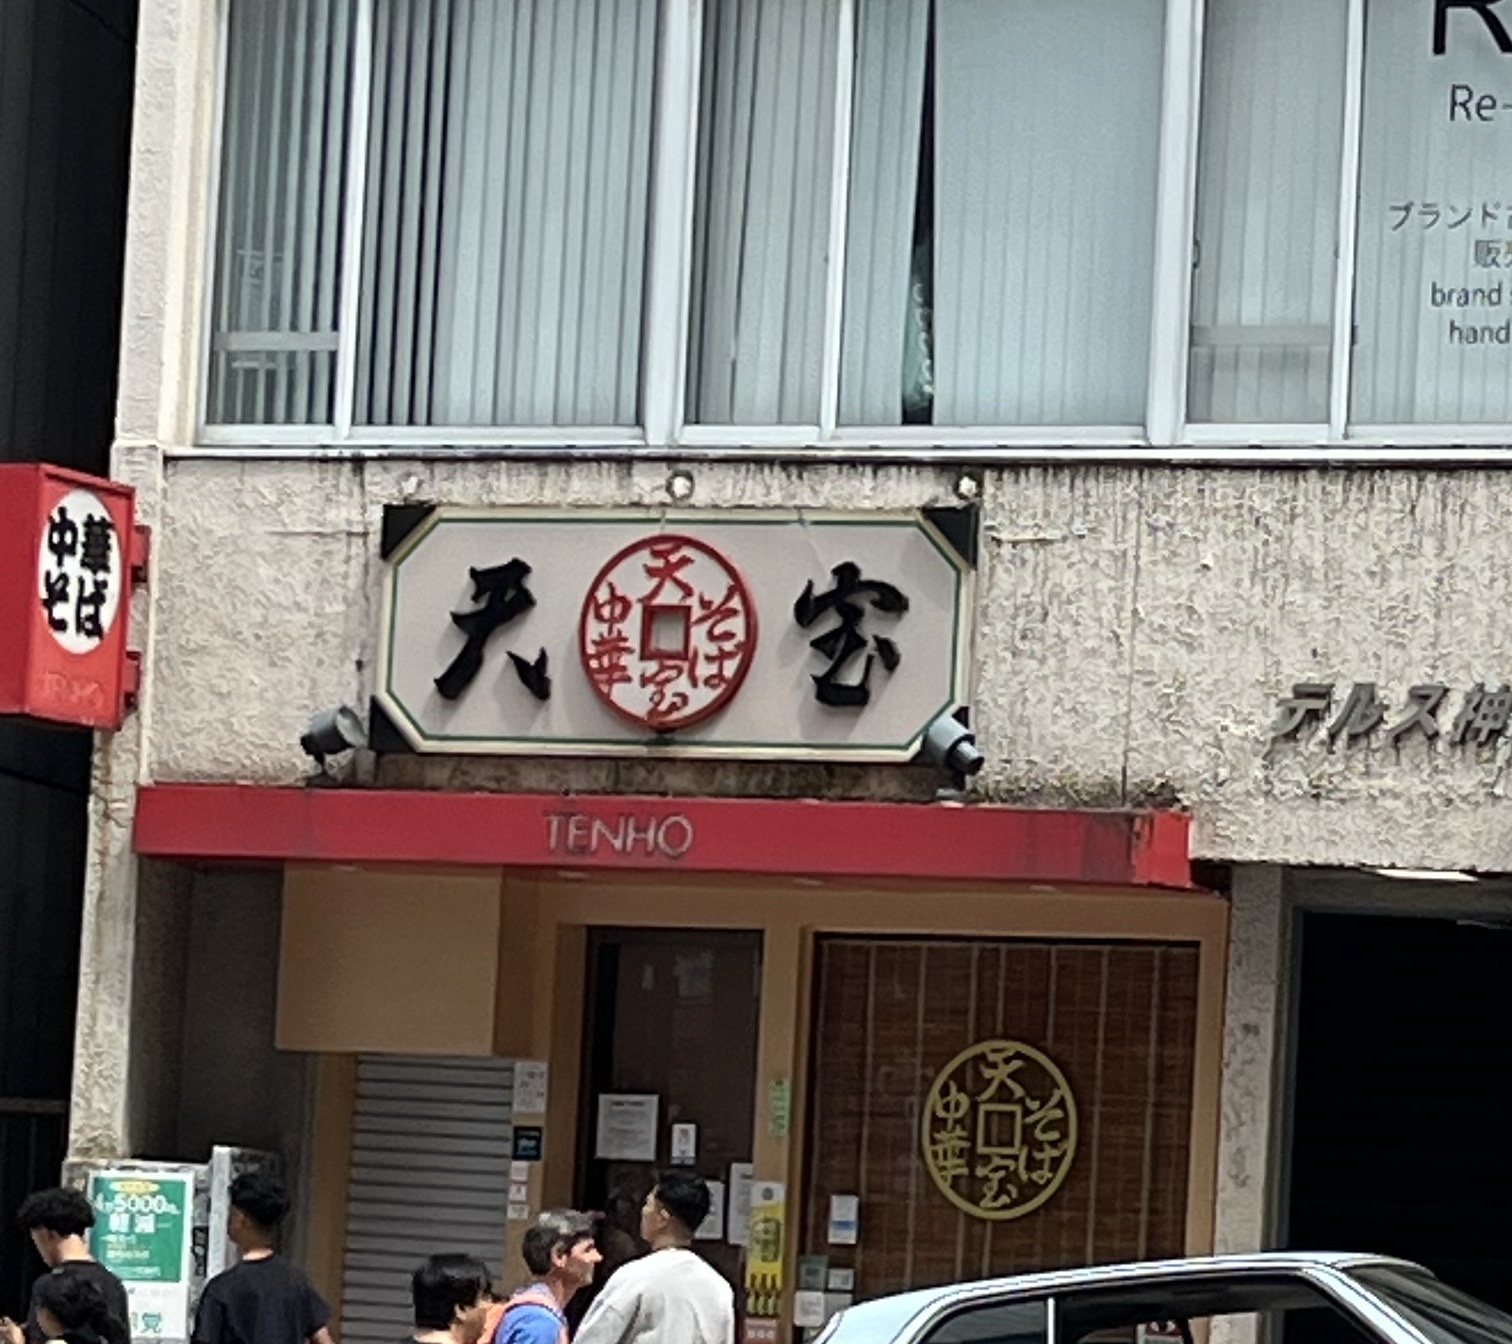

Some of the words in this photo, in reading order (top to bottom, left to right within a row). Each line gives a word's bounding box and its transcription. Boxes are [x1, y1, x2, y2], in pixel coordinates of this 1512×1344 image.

[1431, 281, 1502, 307] brand
[1449, 319, 1511, 346] hand
[41, 570, 107, 639] そば
[546, 814, 694, 856] TENHO
